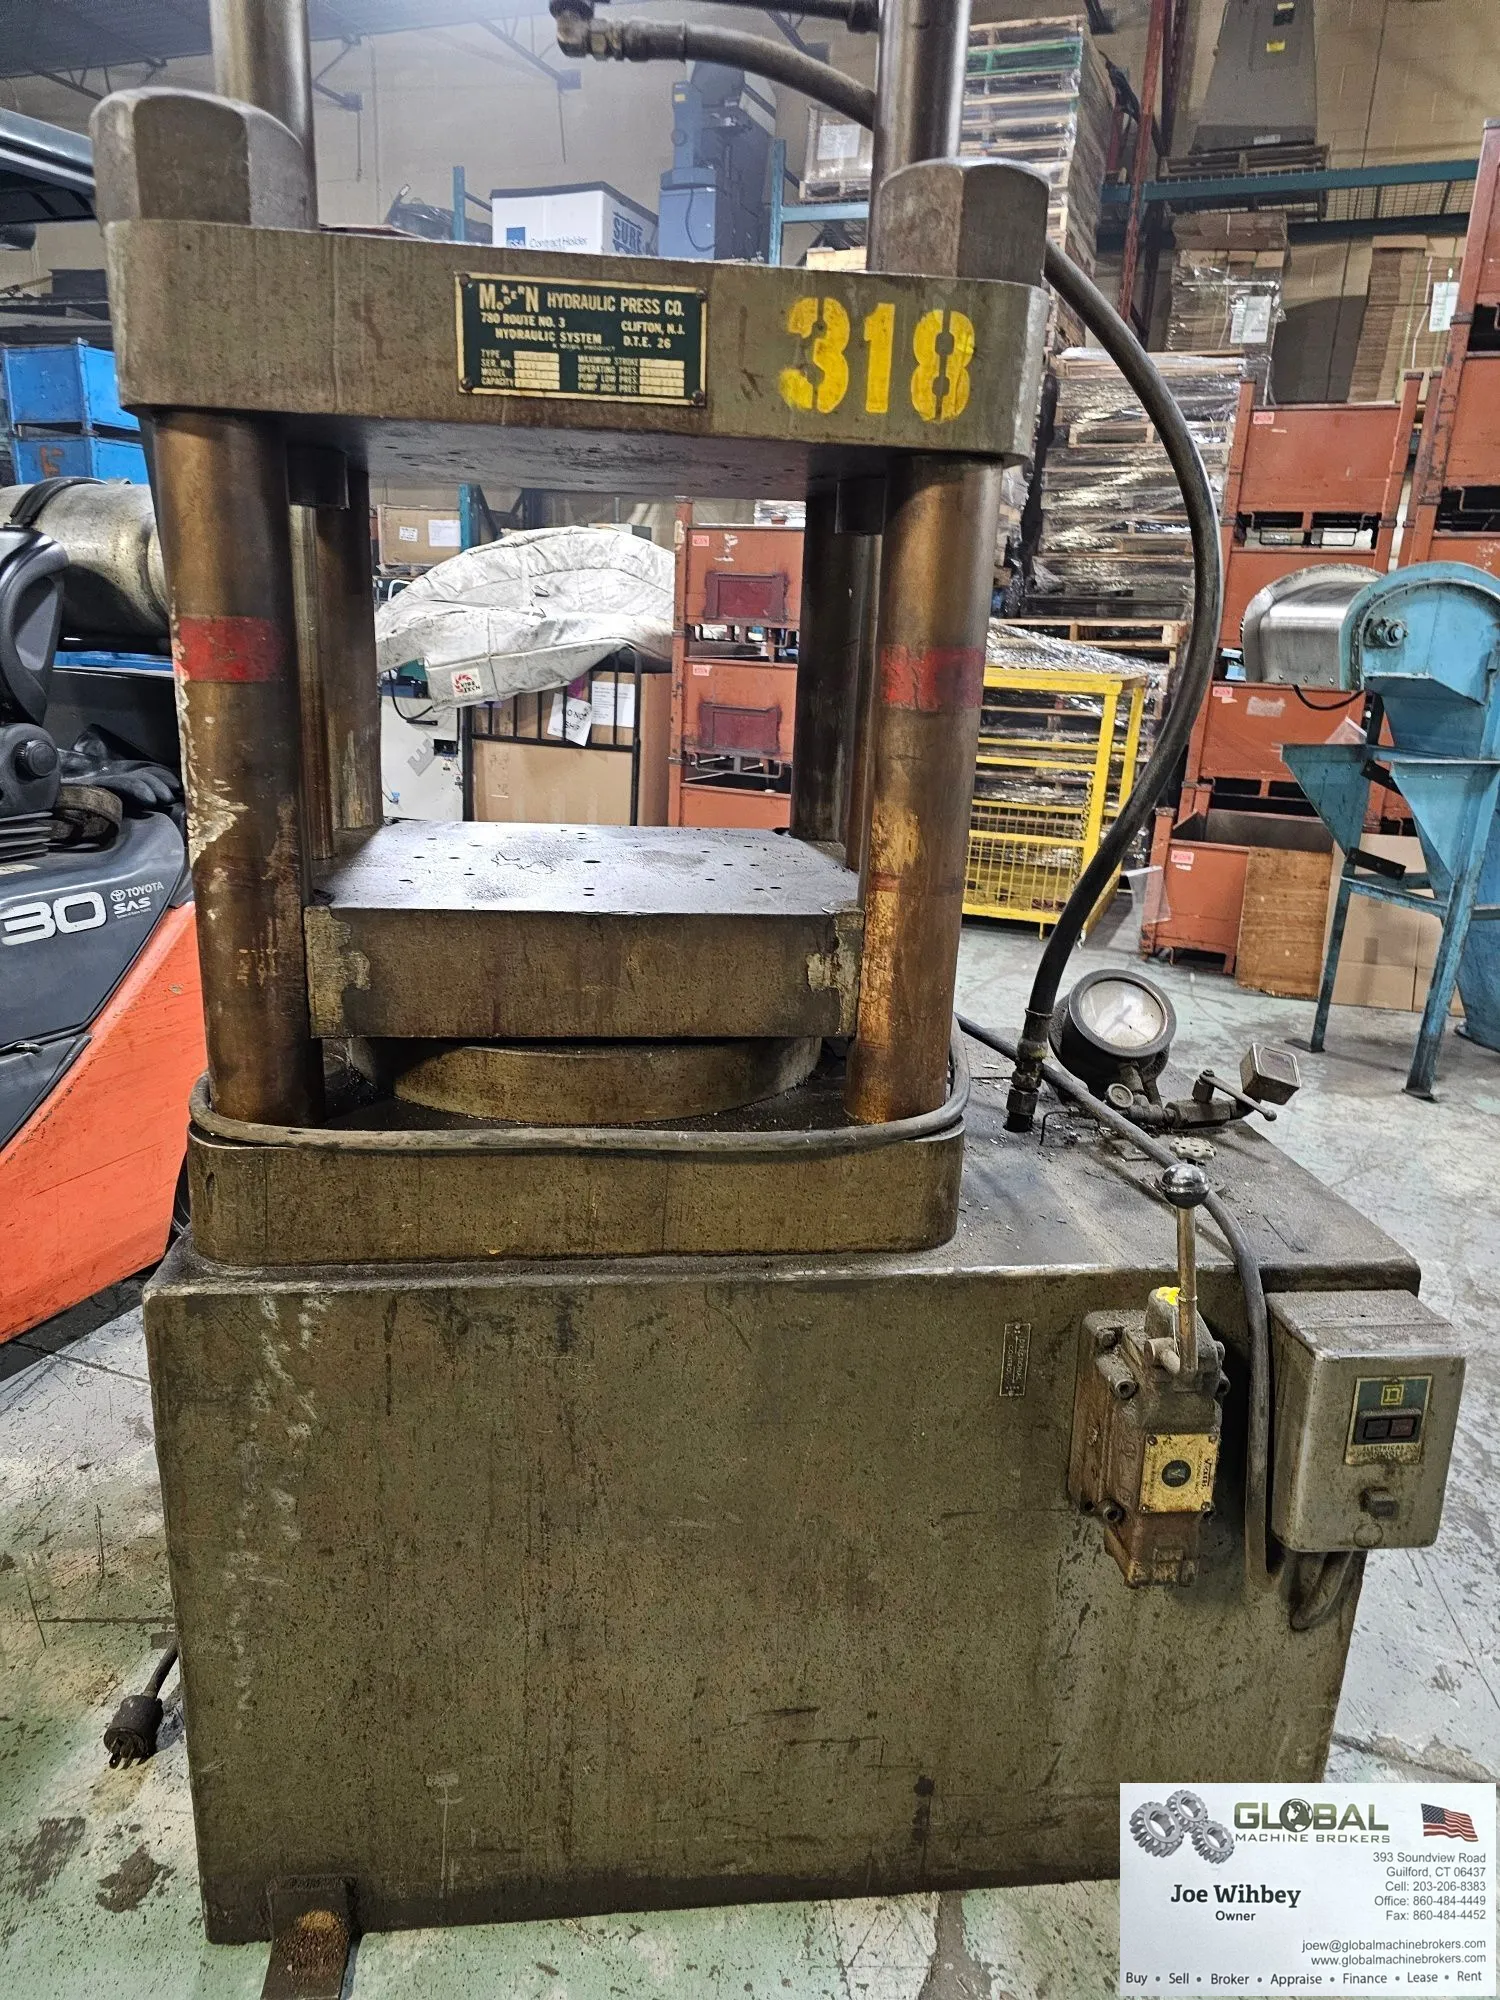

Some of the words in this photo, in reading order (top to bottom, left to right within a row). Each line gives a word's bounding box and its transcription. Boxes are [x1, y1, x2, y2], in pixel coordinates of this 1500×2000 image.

[612, 217, 643, 254] SURE
[547, 291, 616, 312] HYDRAULIC
[620, 296, 661, 315] PRESS
[665, 299, 685, 316] CO.
[502, 313, 536, 327] ROUTE
[538, 315, 555, 328] NO.
[558, 316, 566, 328] 3
[620, 320, 664, 335] CLIFTON,
[667, 322, 686, 335] N.J.
[495, 327, 556, 343] HYDRAULIC
[559, 331, 603, 345] SYSTEM
[623, 335, 652, 348] D.T.E.
[656, 337, 672, 349] 26
[481, 348, 500, 359] TYPE
[778, 296, 975, 424] 318
[125, 881, 165, 898] TOYOTA
[112, 896, 152, 915] SAS
[0, 891, 107, 946] 30
